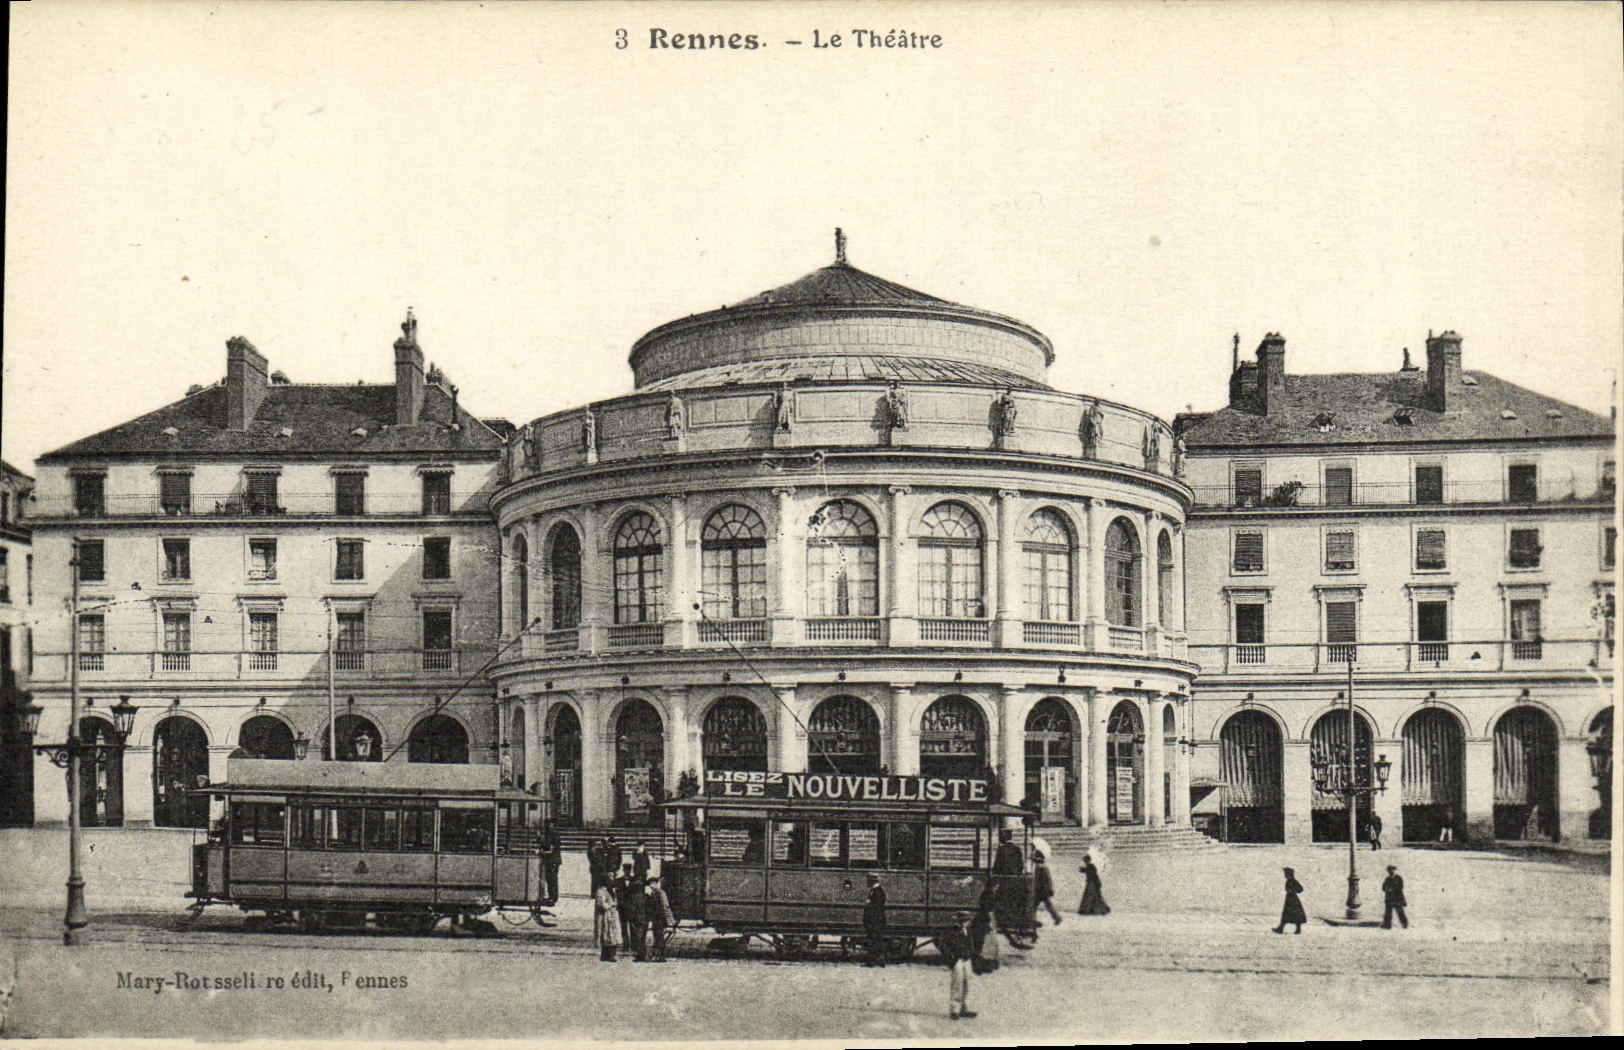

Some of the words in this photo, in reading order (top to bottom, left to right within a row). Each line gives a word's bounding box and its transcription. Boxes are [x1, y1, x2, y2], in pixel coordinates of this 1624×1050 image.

[706, 770, 783, 784] LISEZ
[723, 782, 766, 796] LE
[786, 775, 989, 802] NOUVELLISTE
